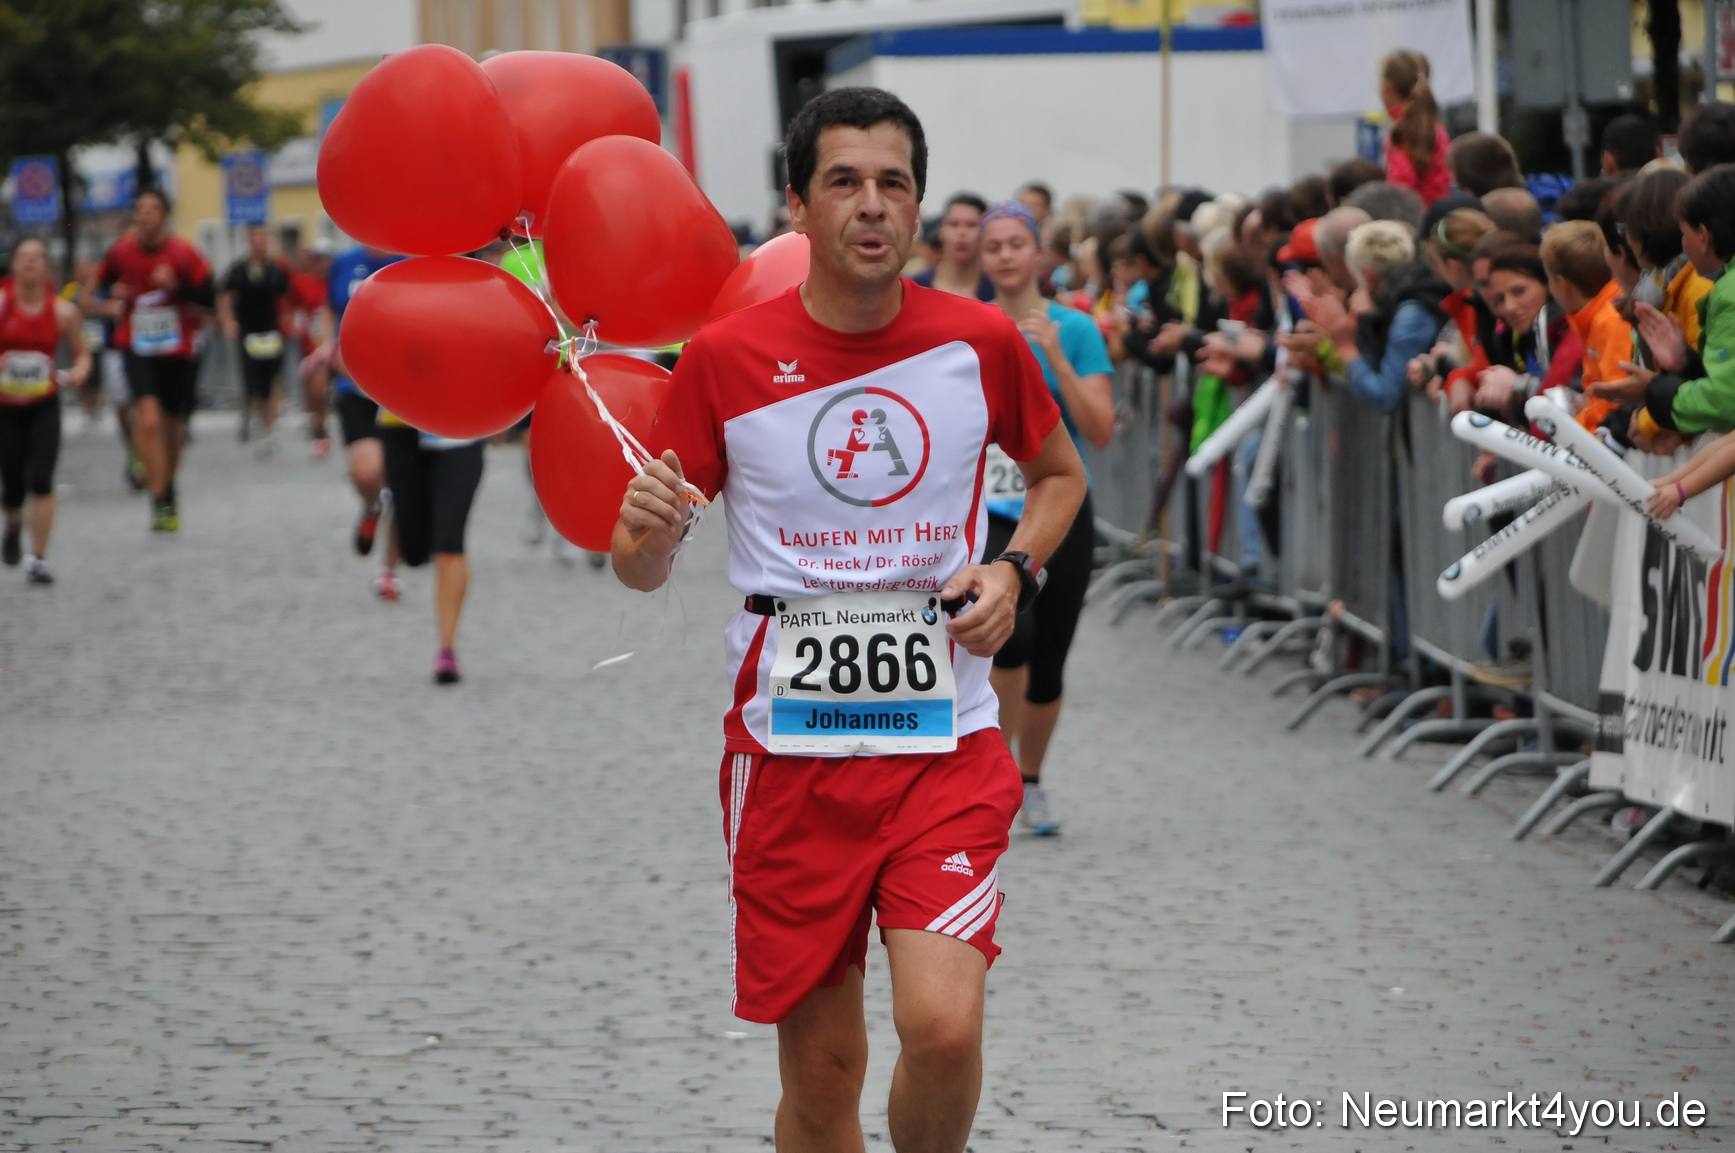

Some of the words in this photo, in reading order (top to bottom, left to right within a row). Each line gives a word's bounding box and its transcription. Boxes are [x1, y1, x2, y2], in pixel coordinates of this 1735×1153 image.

[773, 372, 805, 383] erima
[778, 527, 857, 548] LAUFEN
[867, 528, 905, 545] MIT
[914, 521, 958, 543] HERZ
[798, 558, 820, 570] Dr.
[824, 557, 861, 570] Heck
[876, 556, 897, 569] Dr.
[780, 612, 832, 629] PARTL
[836, 609, 917, 625] Neumarkt
[790, 632, 937, 694] 2866
[776, 685, 784, 696] D
[805, 708, 919, 731] Johannes
[940, 863, 974, 877] adidas
